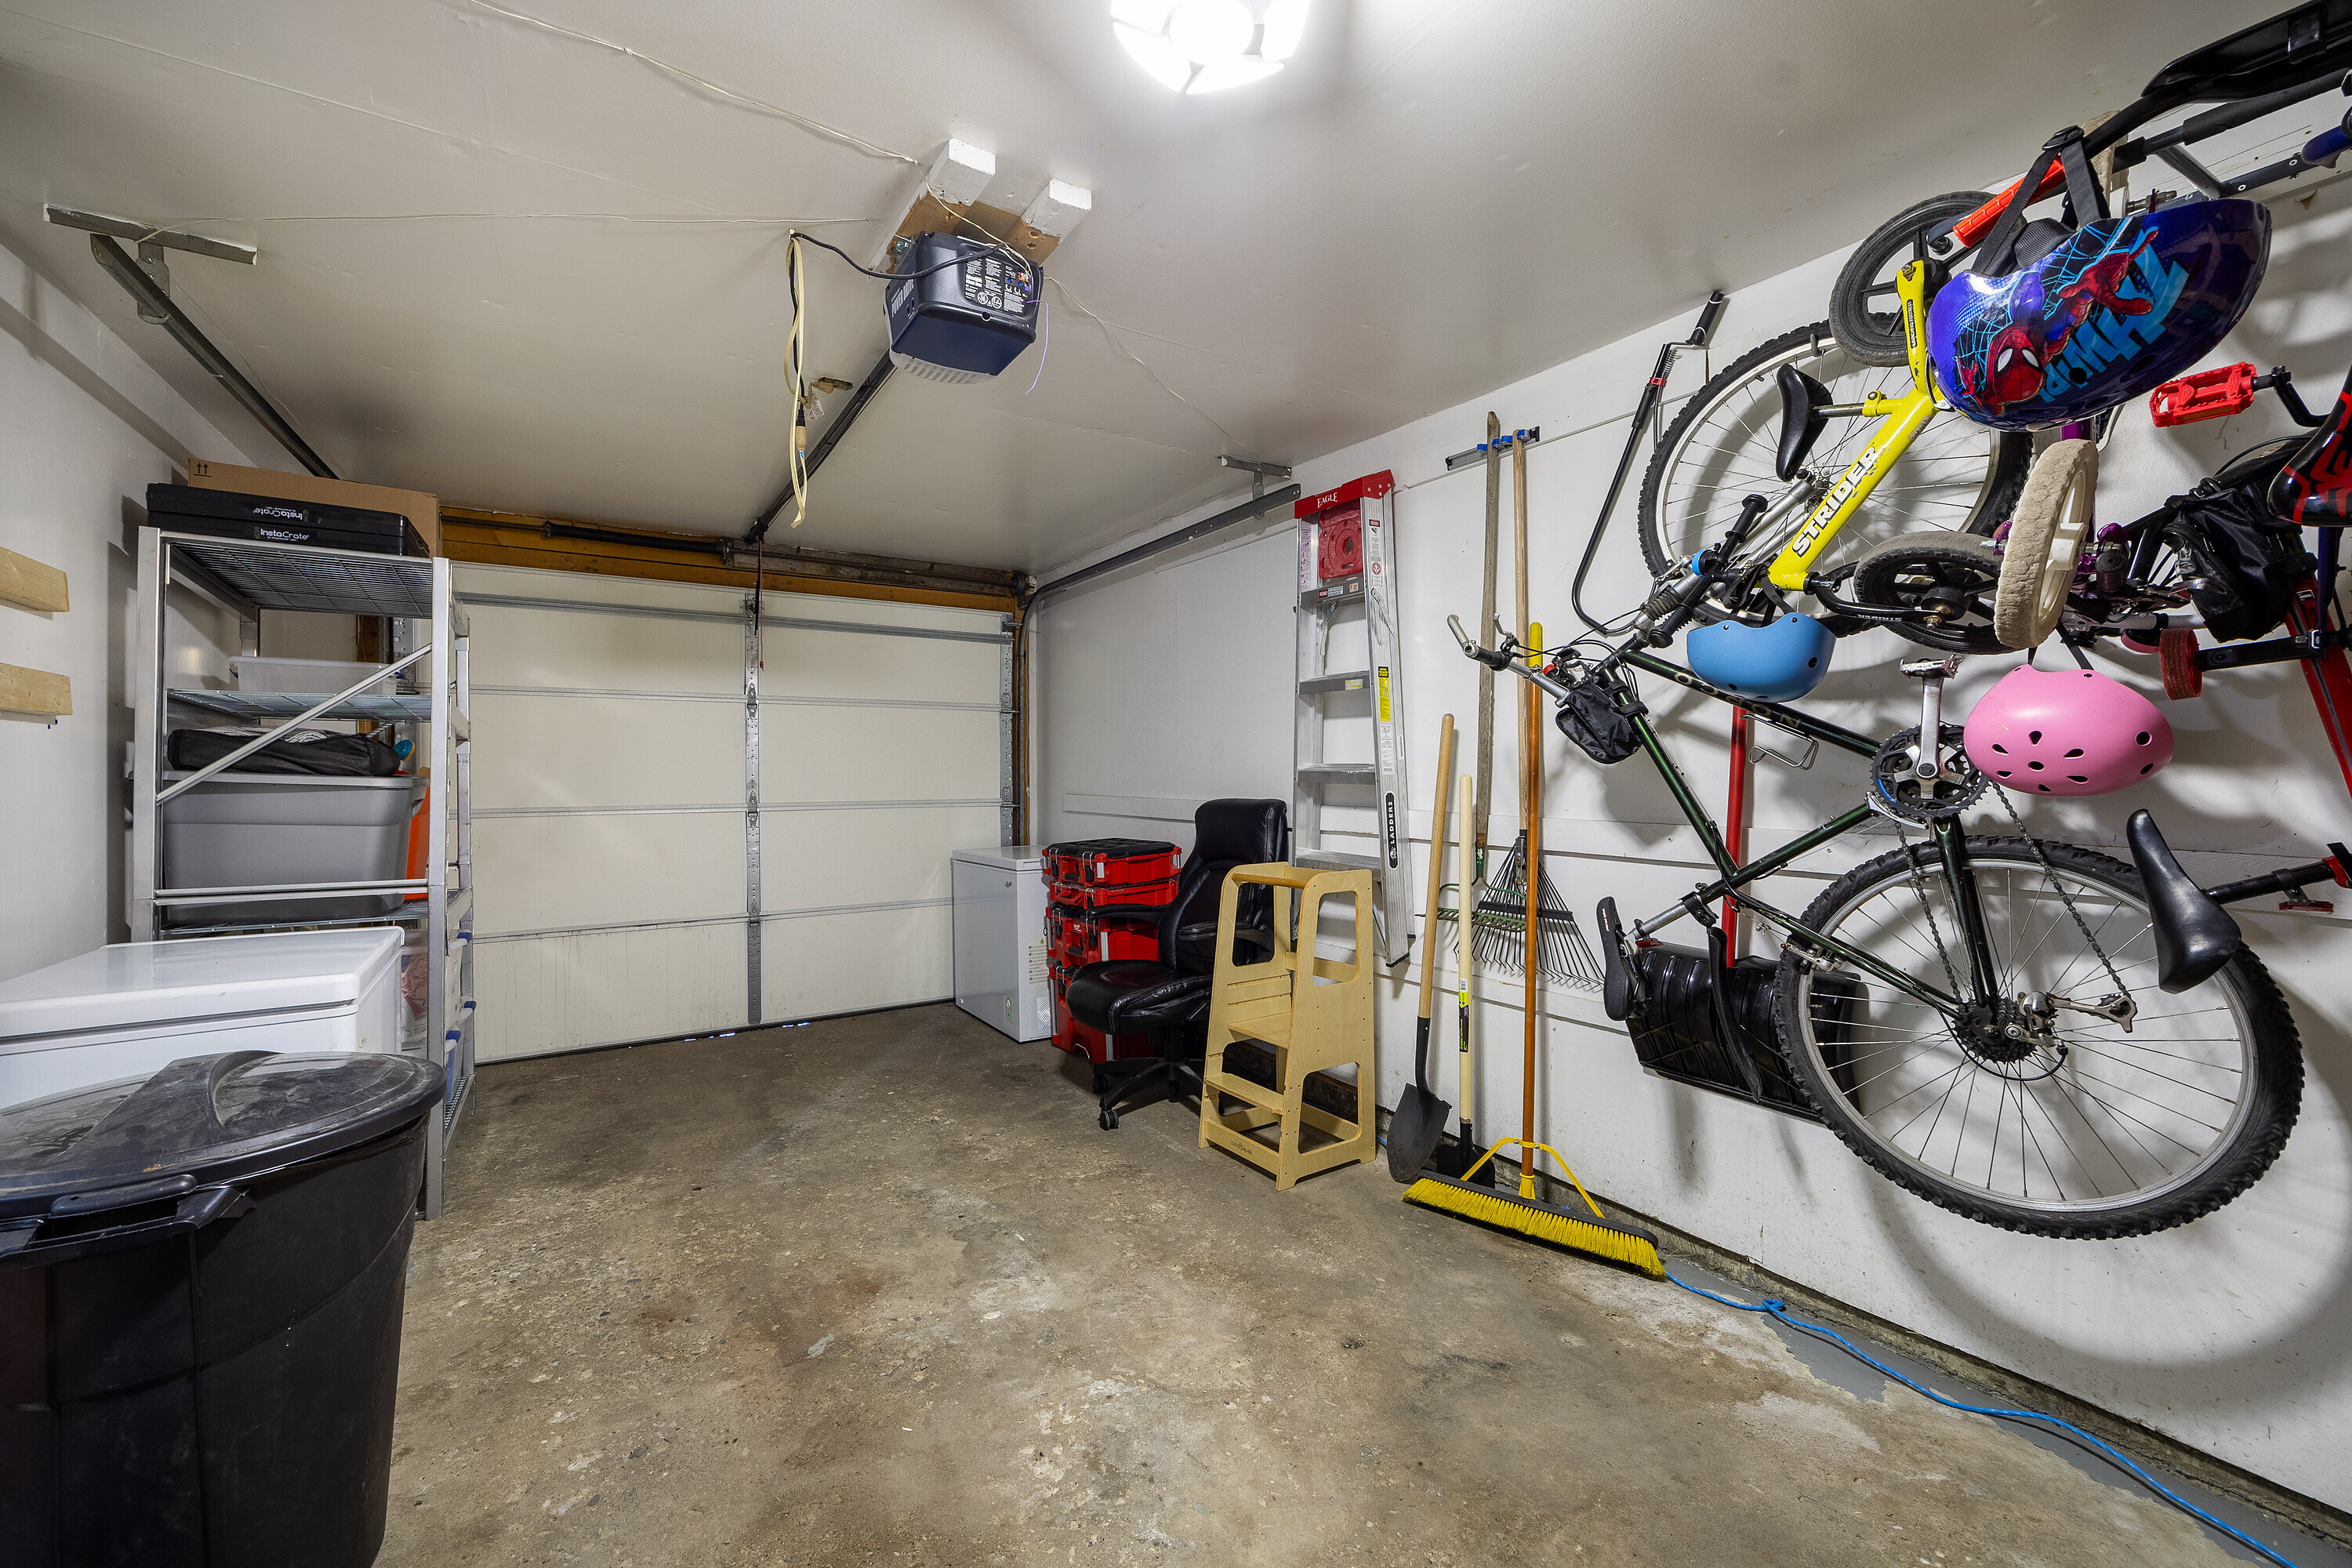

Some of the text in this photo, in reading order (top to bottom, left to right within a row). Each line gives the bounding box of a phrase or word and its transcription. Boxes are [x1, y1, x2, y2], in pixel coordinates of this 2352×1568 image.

[1317, 492, 1338, 509] EAGLE
[1791, 445, 1876, 558] STRIDER
[254, 507, 303, 520] InstaCrate
[260, 528, 309, 540] InstaCrate
[1674, 672, 1802, 729] NORCO
